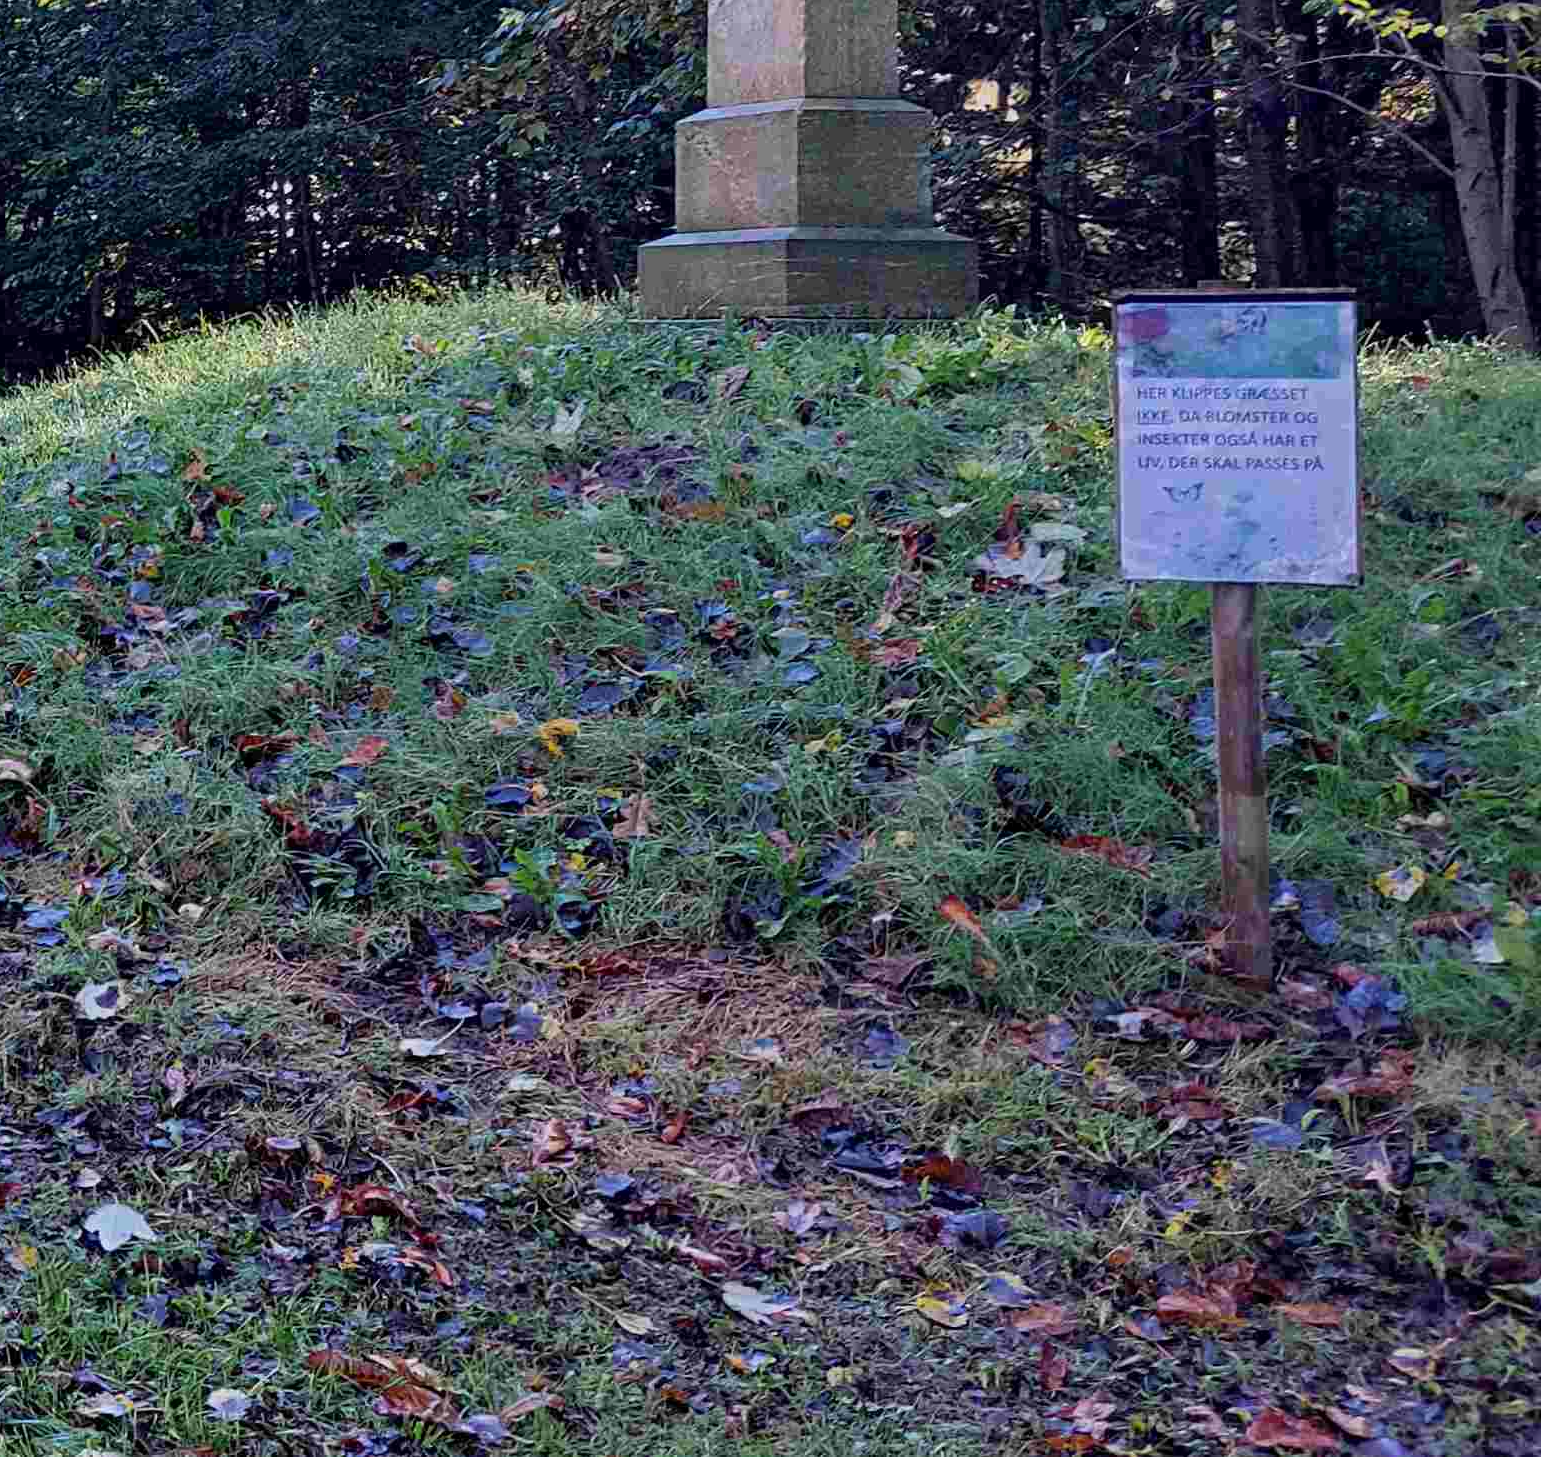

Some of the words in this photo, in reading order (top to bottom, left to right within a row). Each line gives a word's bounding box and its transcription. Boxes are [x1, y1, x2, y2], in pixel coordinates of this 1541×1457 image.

[1136, 387, 1167, 400] HER
[1172, 387, 1230, 400] KLIPPES
[1235, 387, 1308, 400] GRÆSSET
[1179, 410, 1200, 423] DA
[1205, 410, 1289, 424] BLOMSTER
[1294, 411, 1318, 424] OG
[1138, 432, 1209, 446] INSEKTER
[1214, 431, 1257, 447] OGSÅ
[1263, 435, 1294, 447] HAR
[1301, 435, 1318, 447] ET
[1169, 456, 1198, 469] DER
[1204, 457, 1241, 470] SKAL
[1246, 458, 1300, 471] PASSES
[1304, 456, 1324, 471] PÅ
